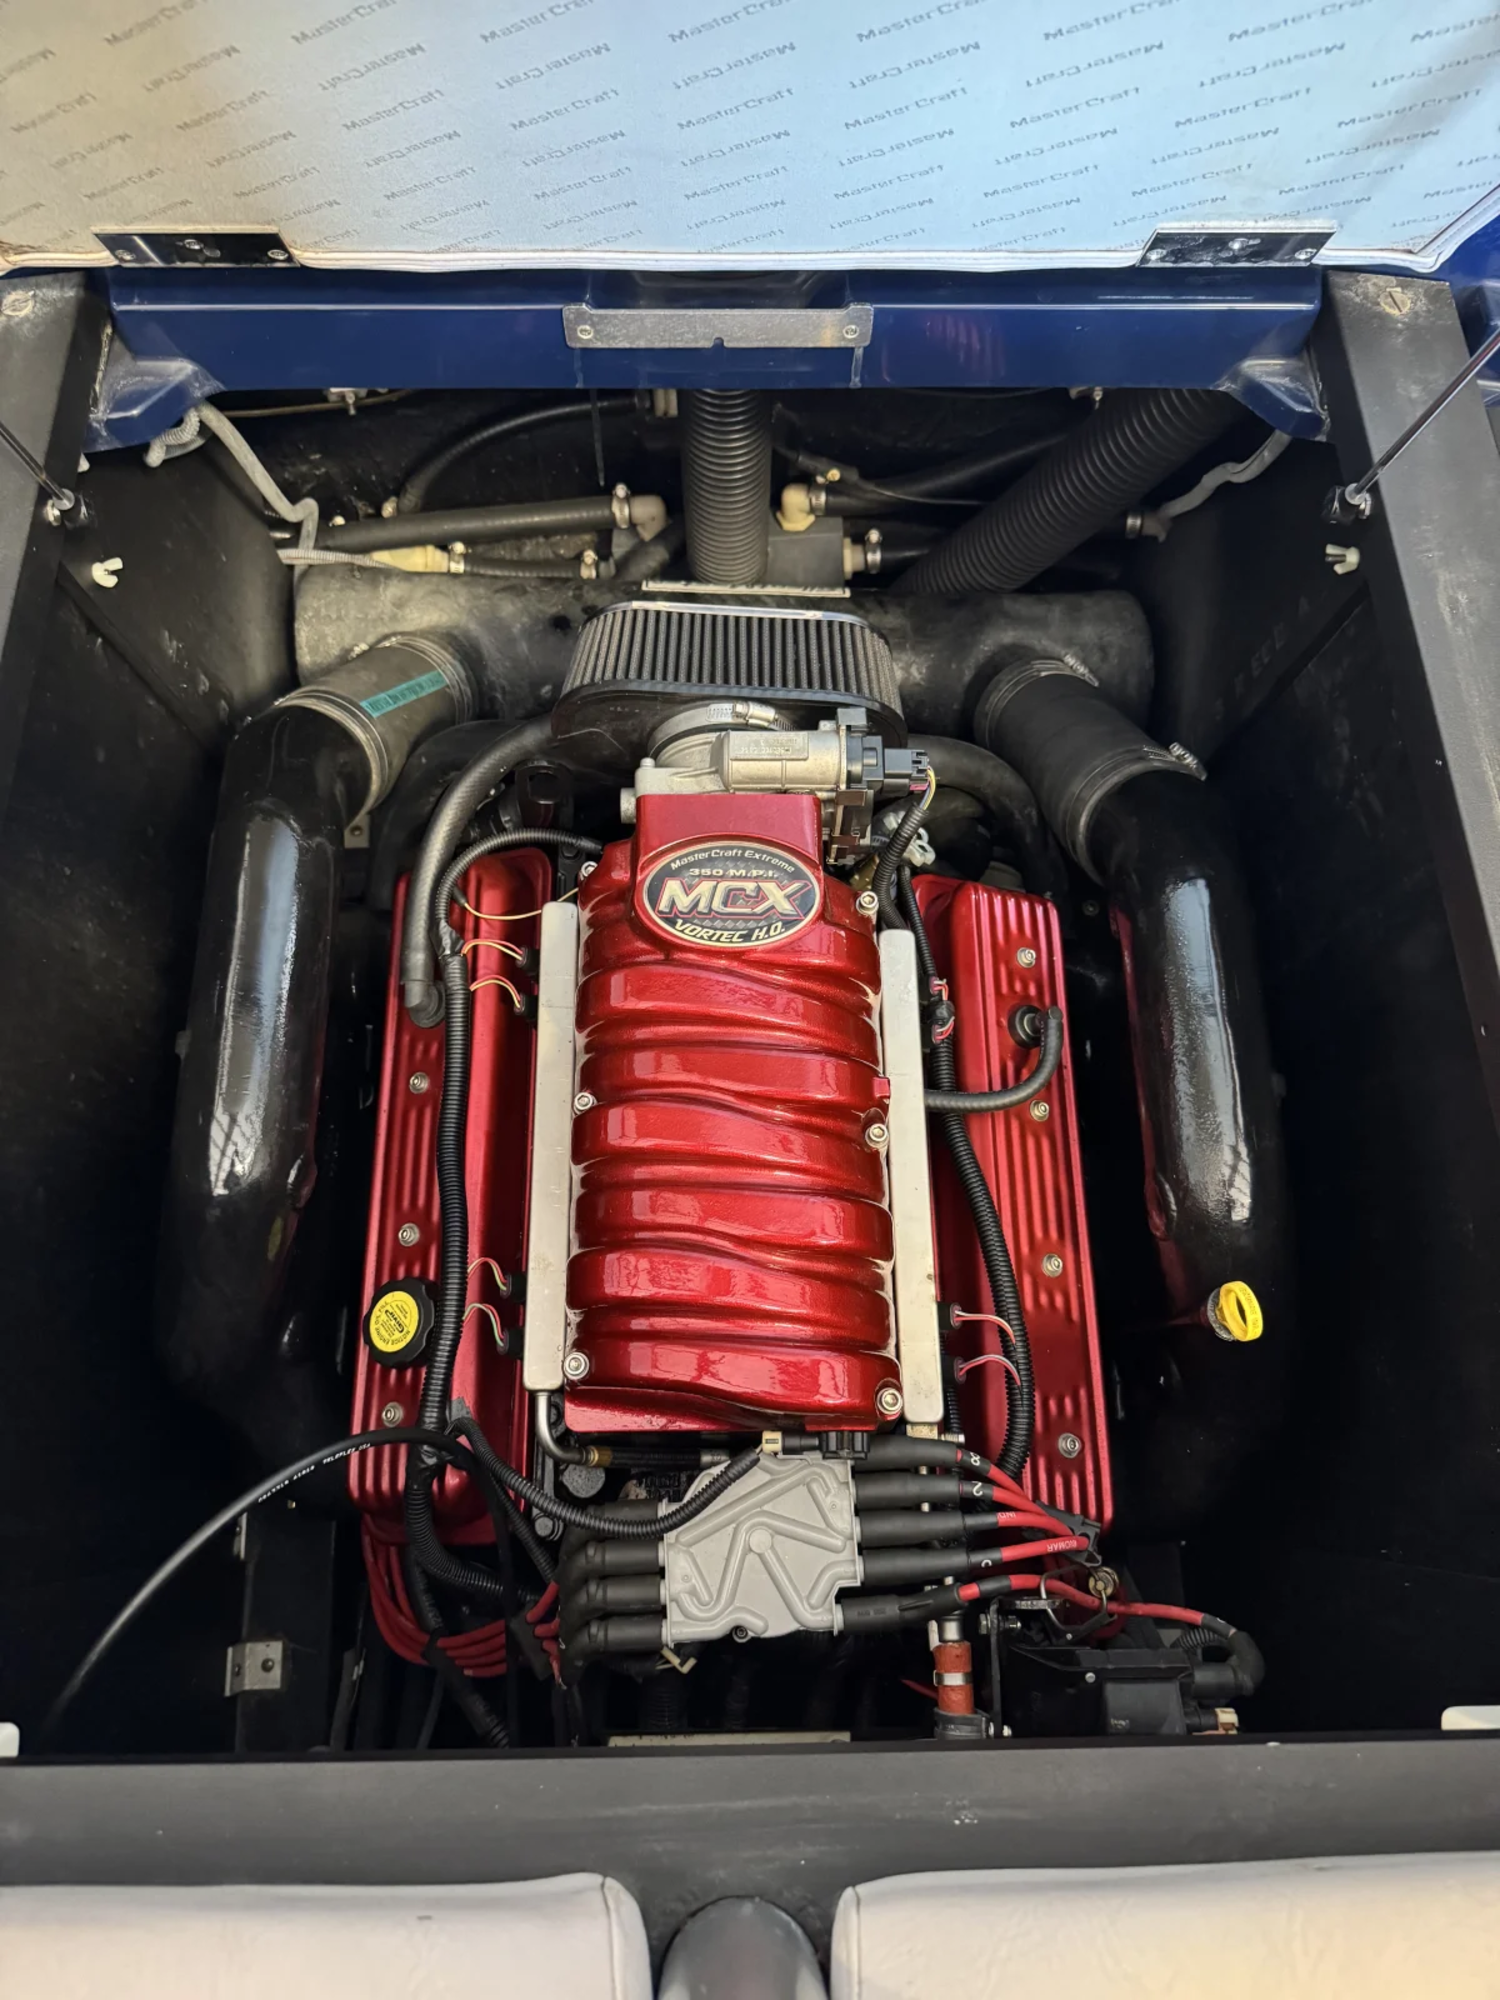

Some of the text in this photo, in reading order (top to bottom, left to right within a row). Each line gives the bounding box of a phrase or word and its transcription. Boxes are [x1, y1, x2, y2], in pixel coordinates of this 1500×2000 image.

[670, 849, 796, 873] MasterCraft Extreme
[689, 868, 723, 877] 350
[656, 878, 812, 919] MCX
[674, 918, 786, 942] VORTEC H.O.
[972, 1480, 983, 1497] 2
